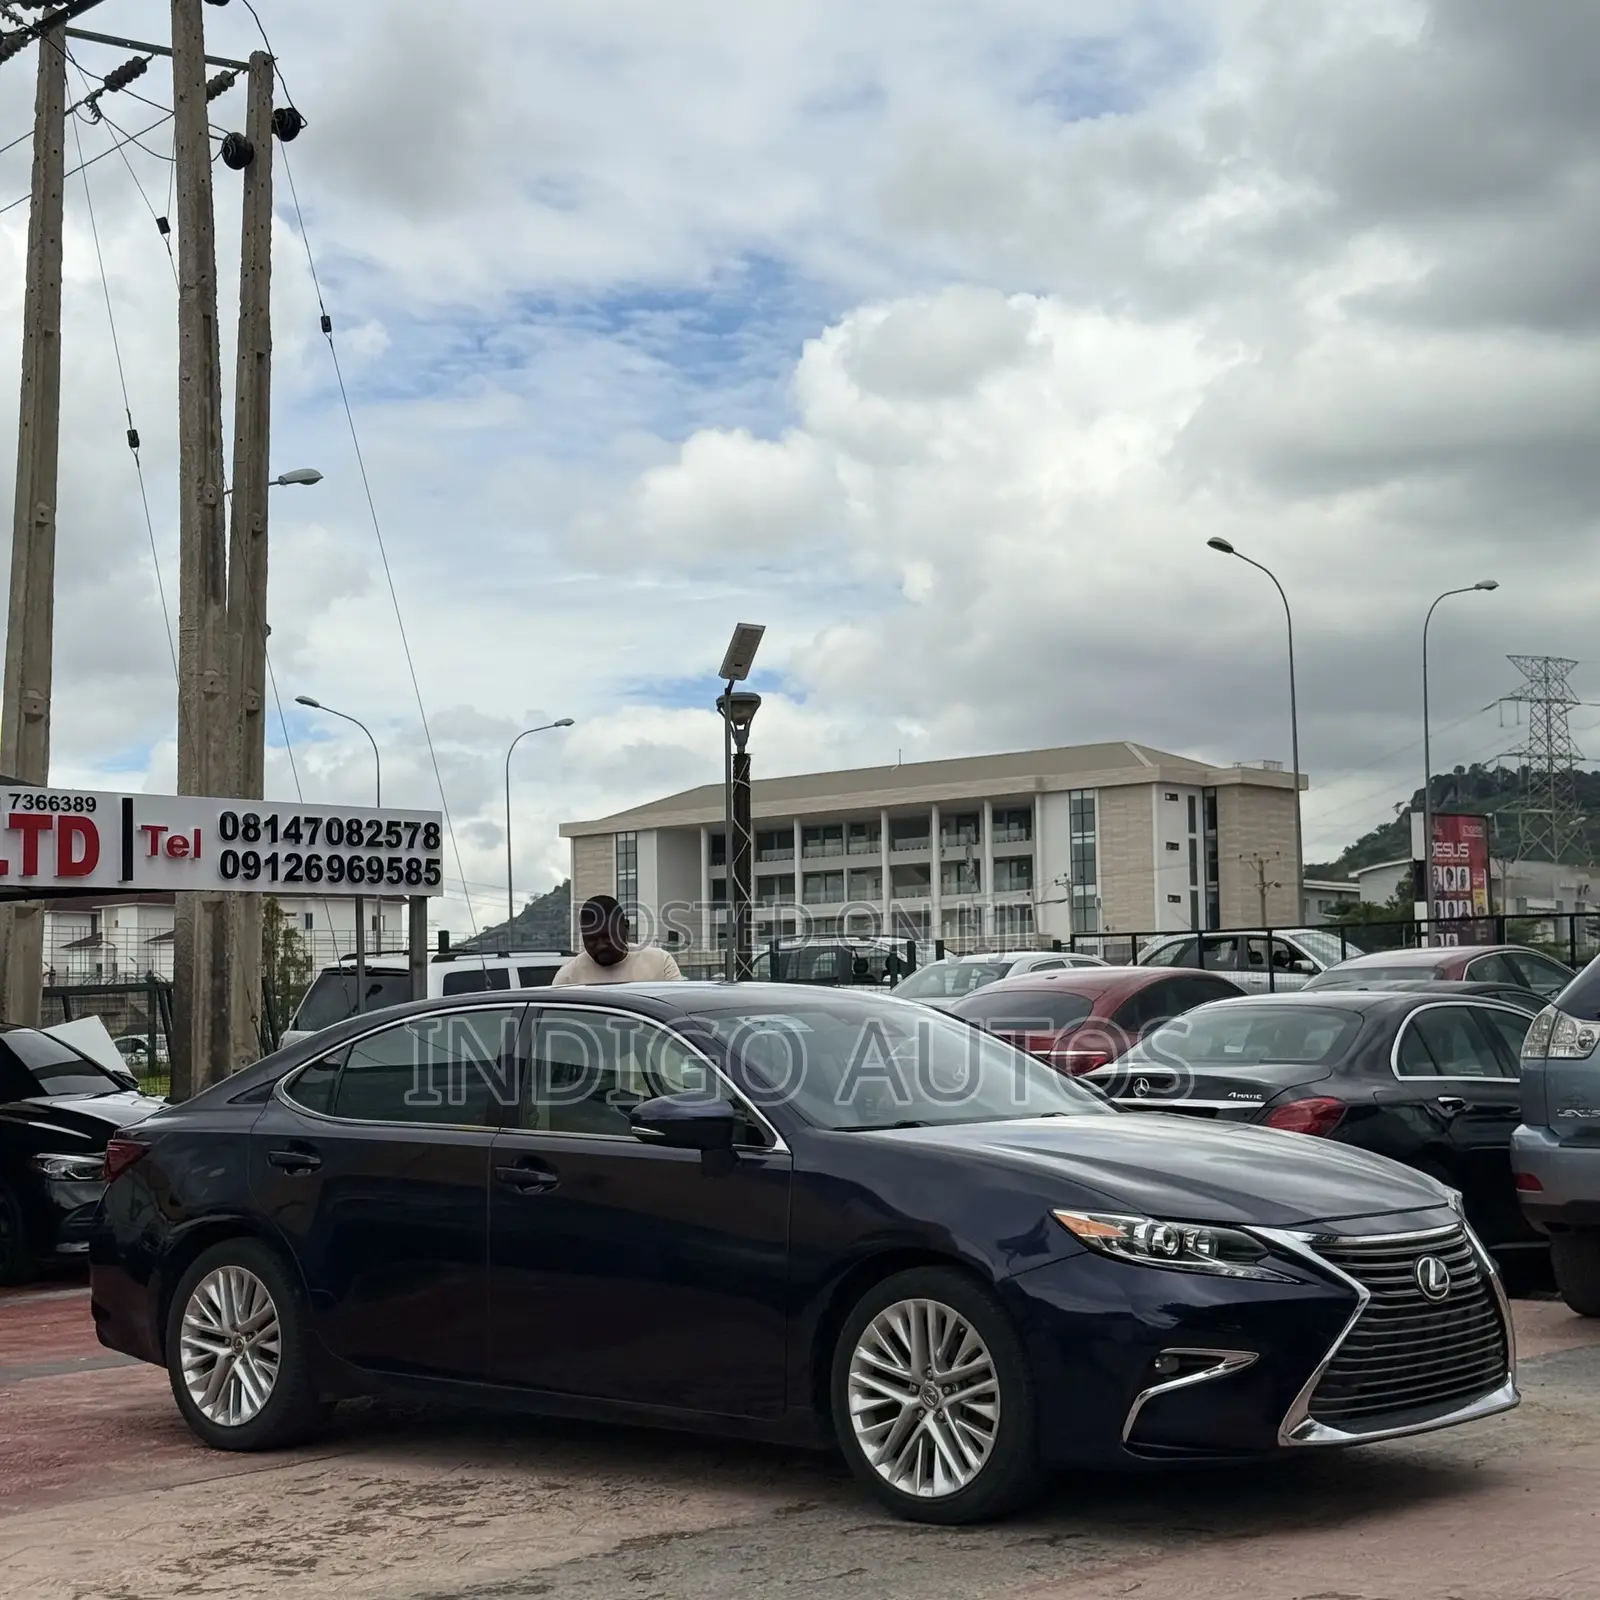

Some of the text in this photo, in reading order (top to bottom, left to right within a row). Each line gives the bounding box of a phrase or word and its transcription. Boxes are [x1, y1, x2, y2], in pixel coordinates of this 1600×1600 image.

[8, 793, 97, 813] 7366389
[0, 813, 100, 877] TD
[138, 824, 202, 859] Tel
[218, 811, 441, 850] 08147082578
[218, 849, 441, 885] 09126969585
